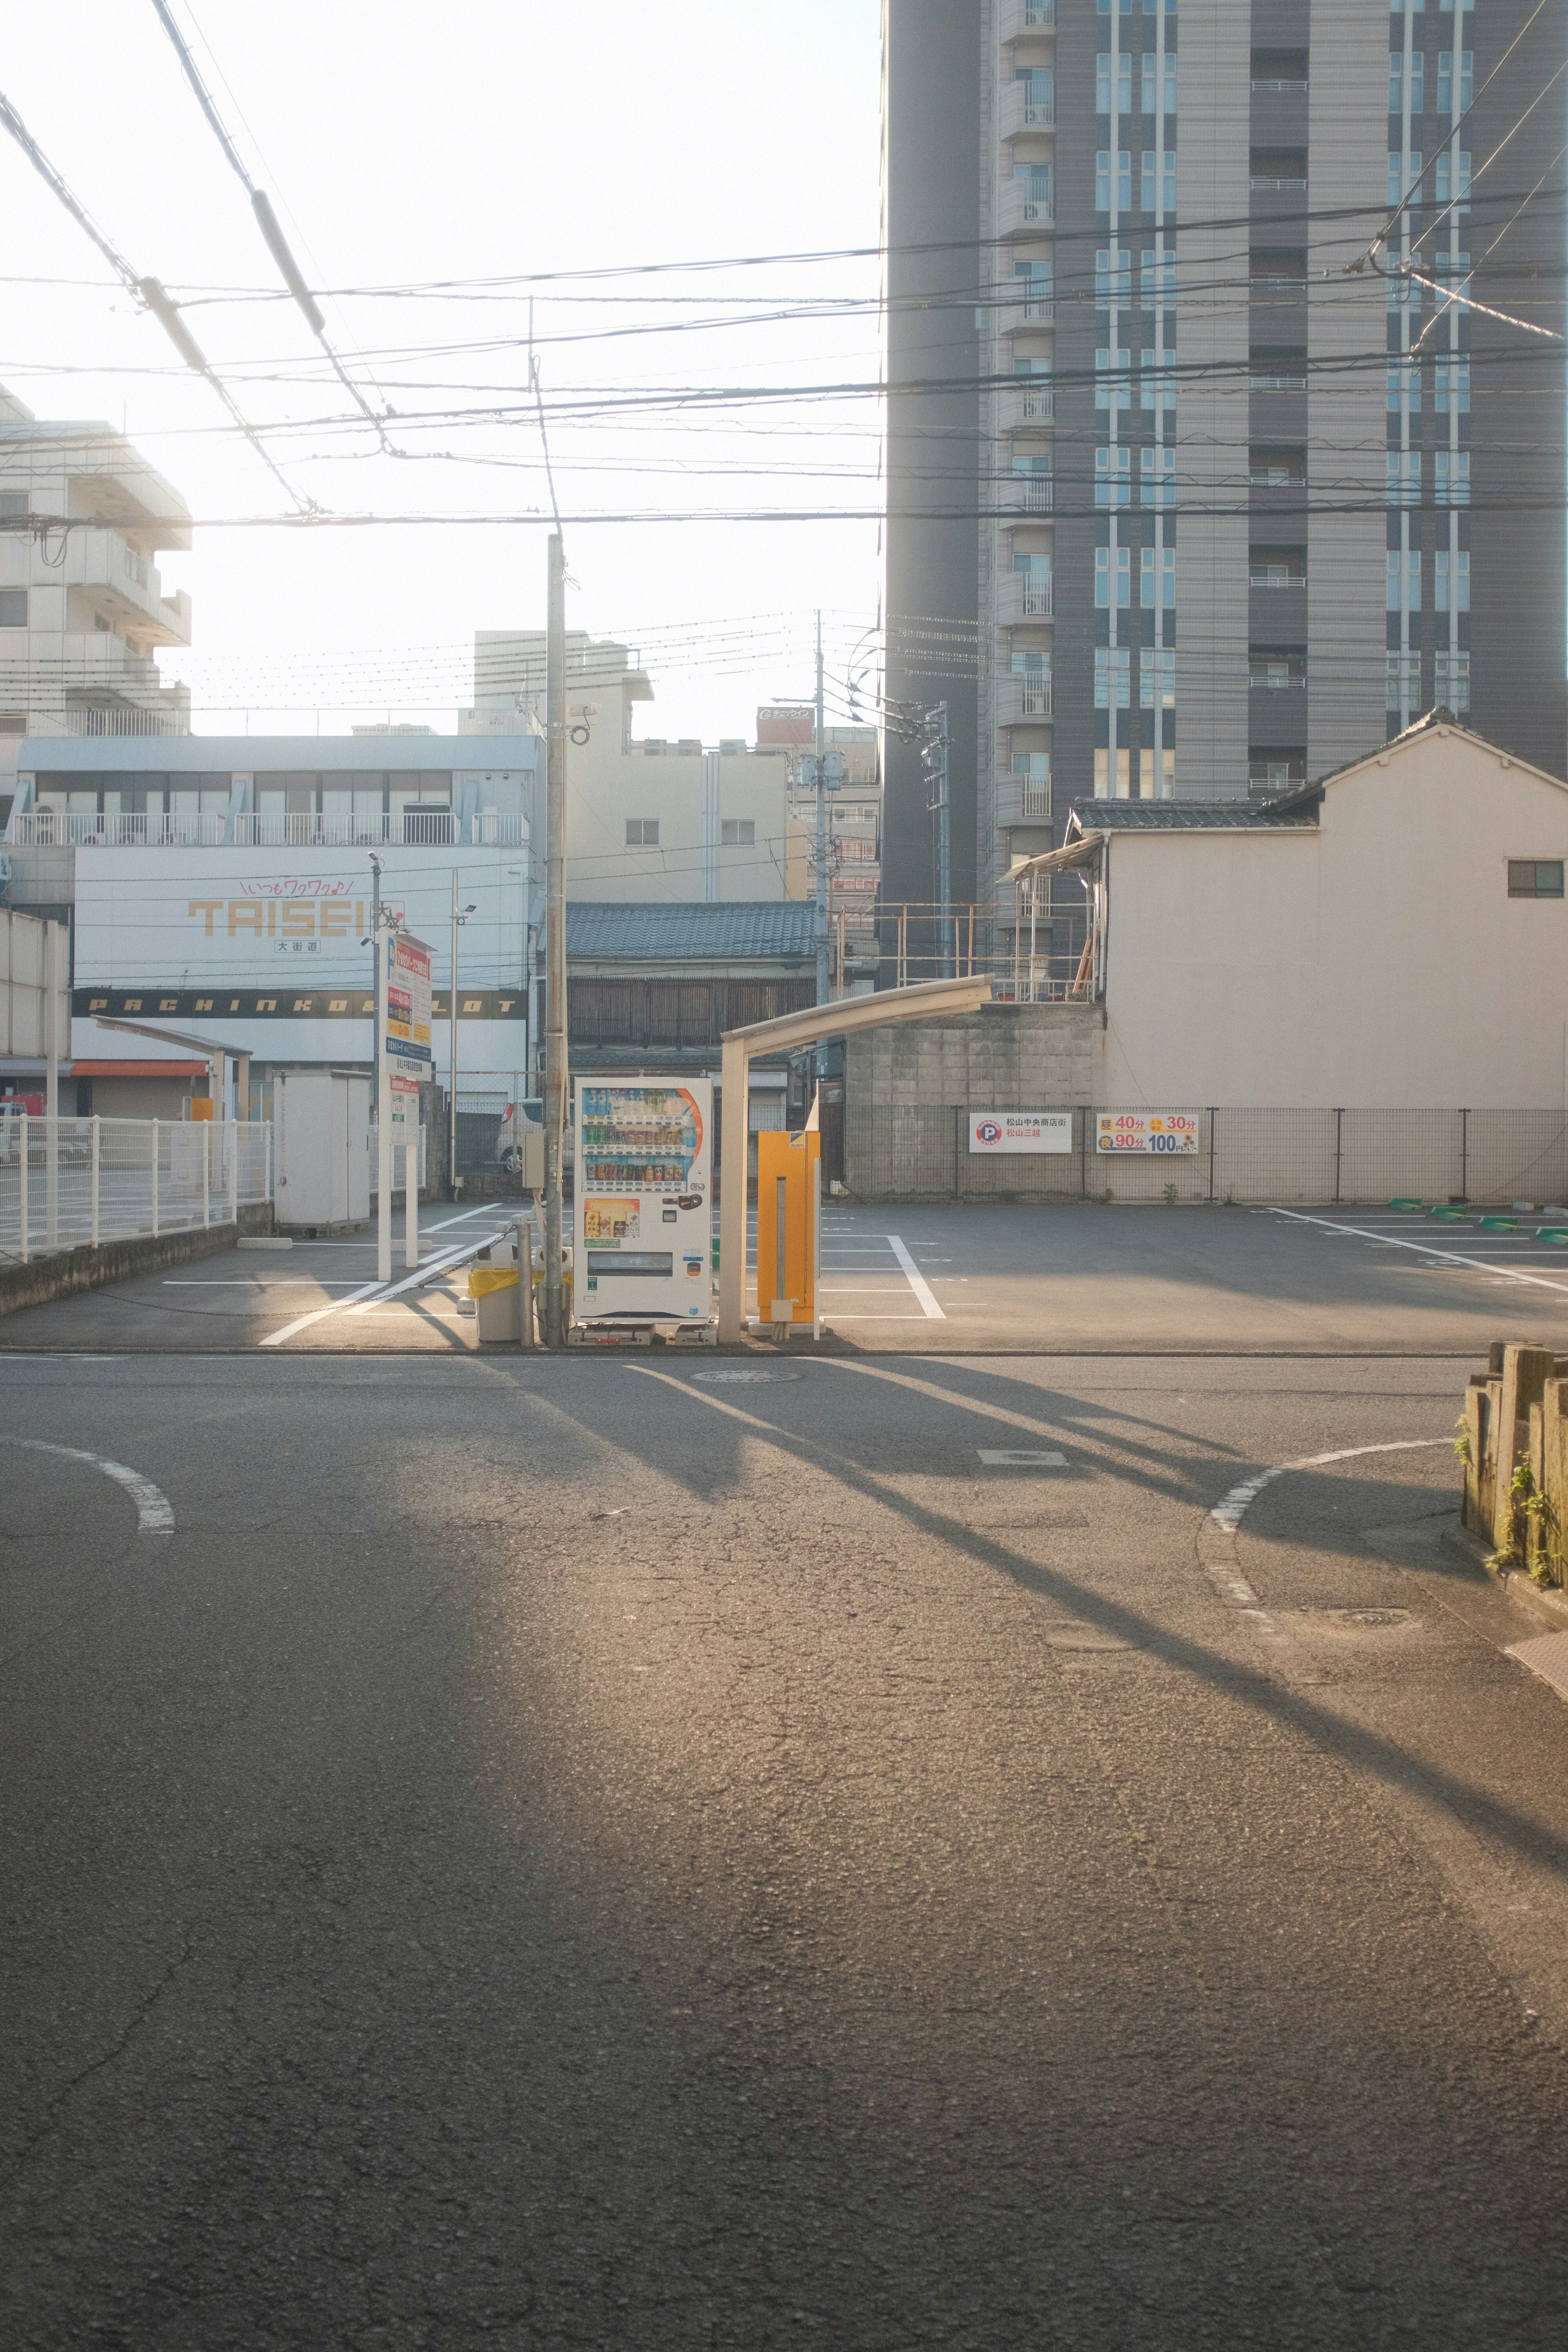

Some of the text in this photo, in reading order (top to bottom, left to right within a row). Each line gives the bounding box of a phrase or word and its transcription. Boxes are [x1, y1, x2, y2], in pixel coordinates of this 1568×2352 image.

[188, 900, 364, 937] TAISEI
[278, 942, 317, 951] 大街道
[89, 999, 348, 1011] PACHINKO
[1006, 1118, 1066, 1126] 松山中央商店街
[1101, 1116, 1144, 1130] 昼 40分
[1167, 1116, 1195, 1130] 30分
[985, 1127, 996, 1139] P
[1007, 1129, 1041, 1137] 松山三越
[1100, 1134, 1144, 1149] 夜 90分
[1148, 1134, 1183, 1152] 100円
